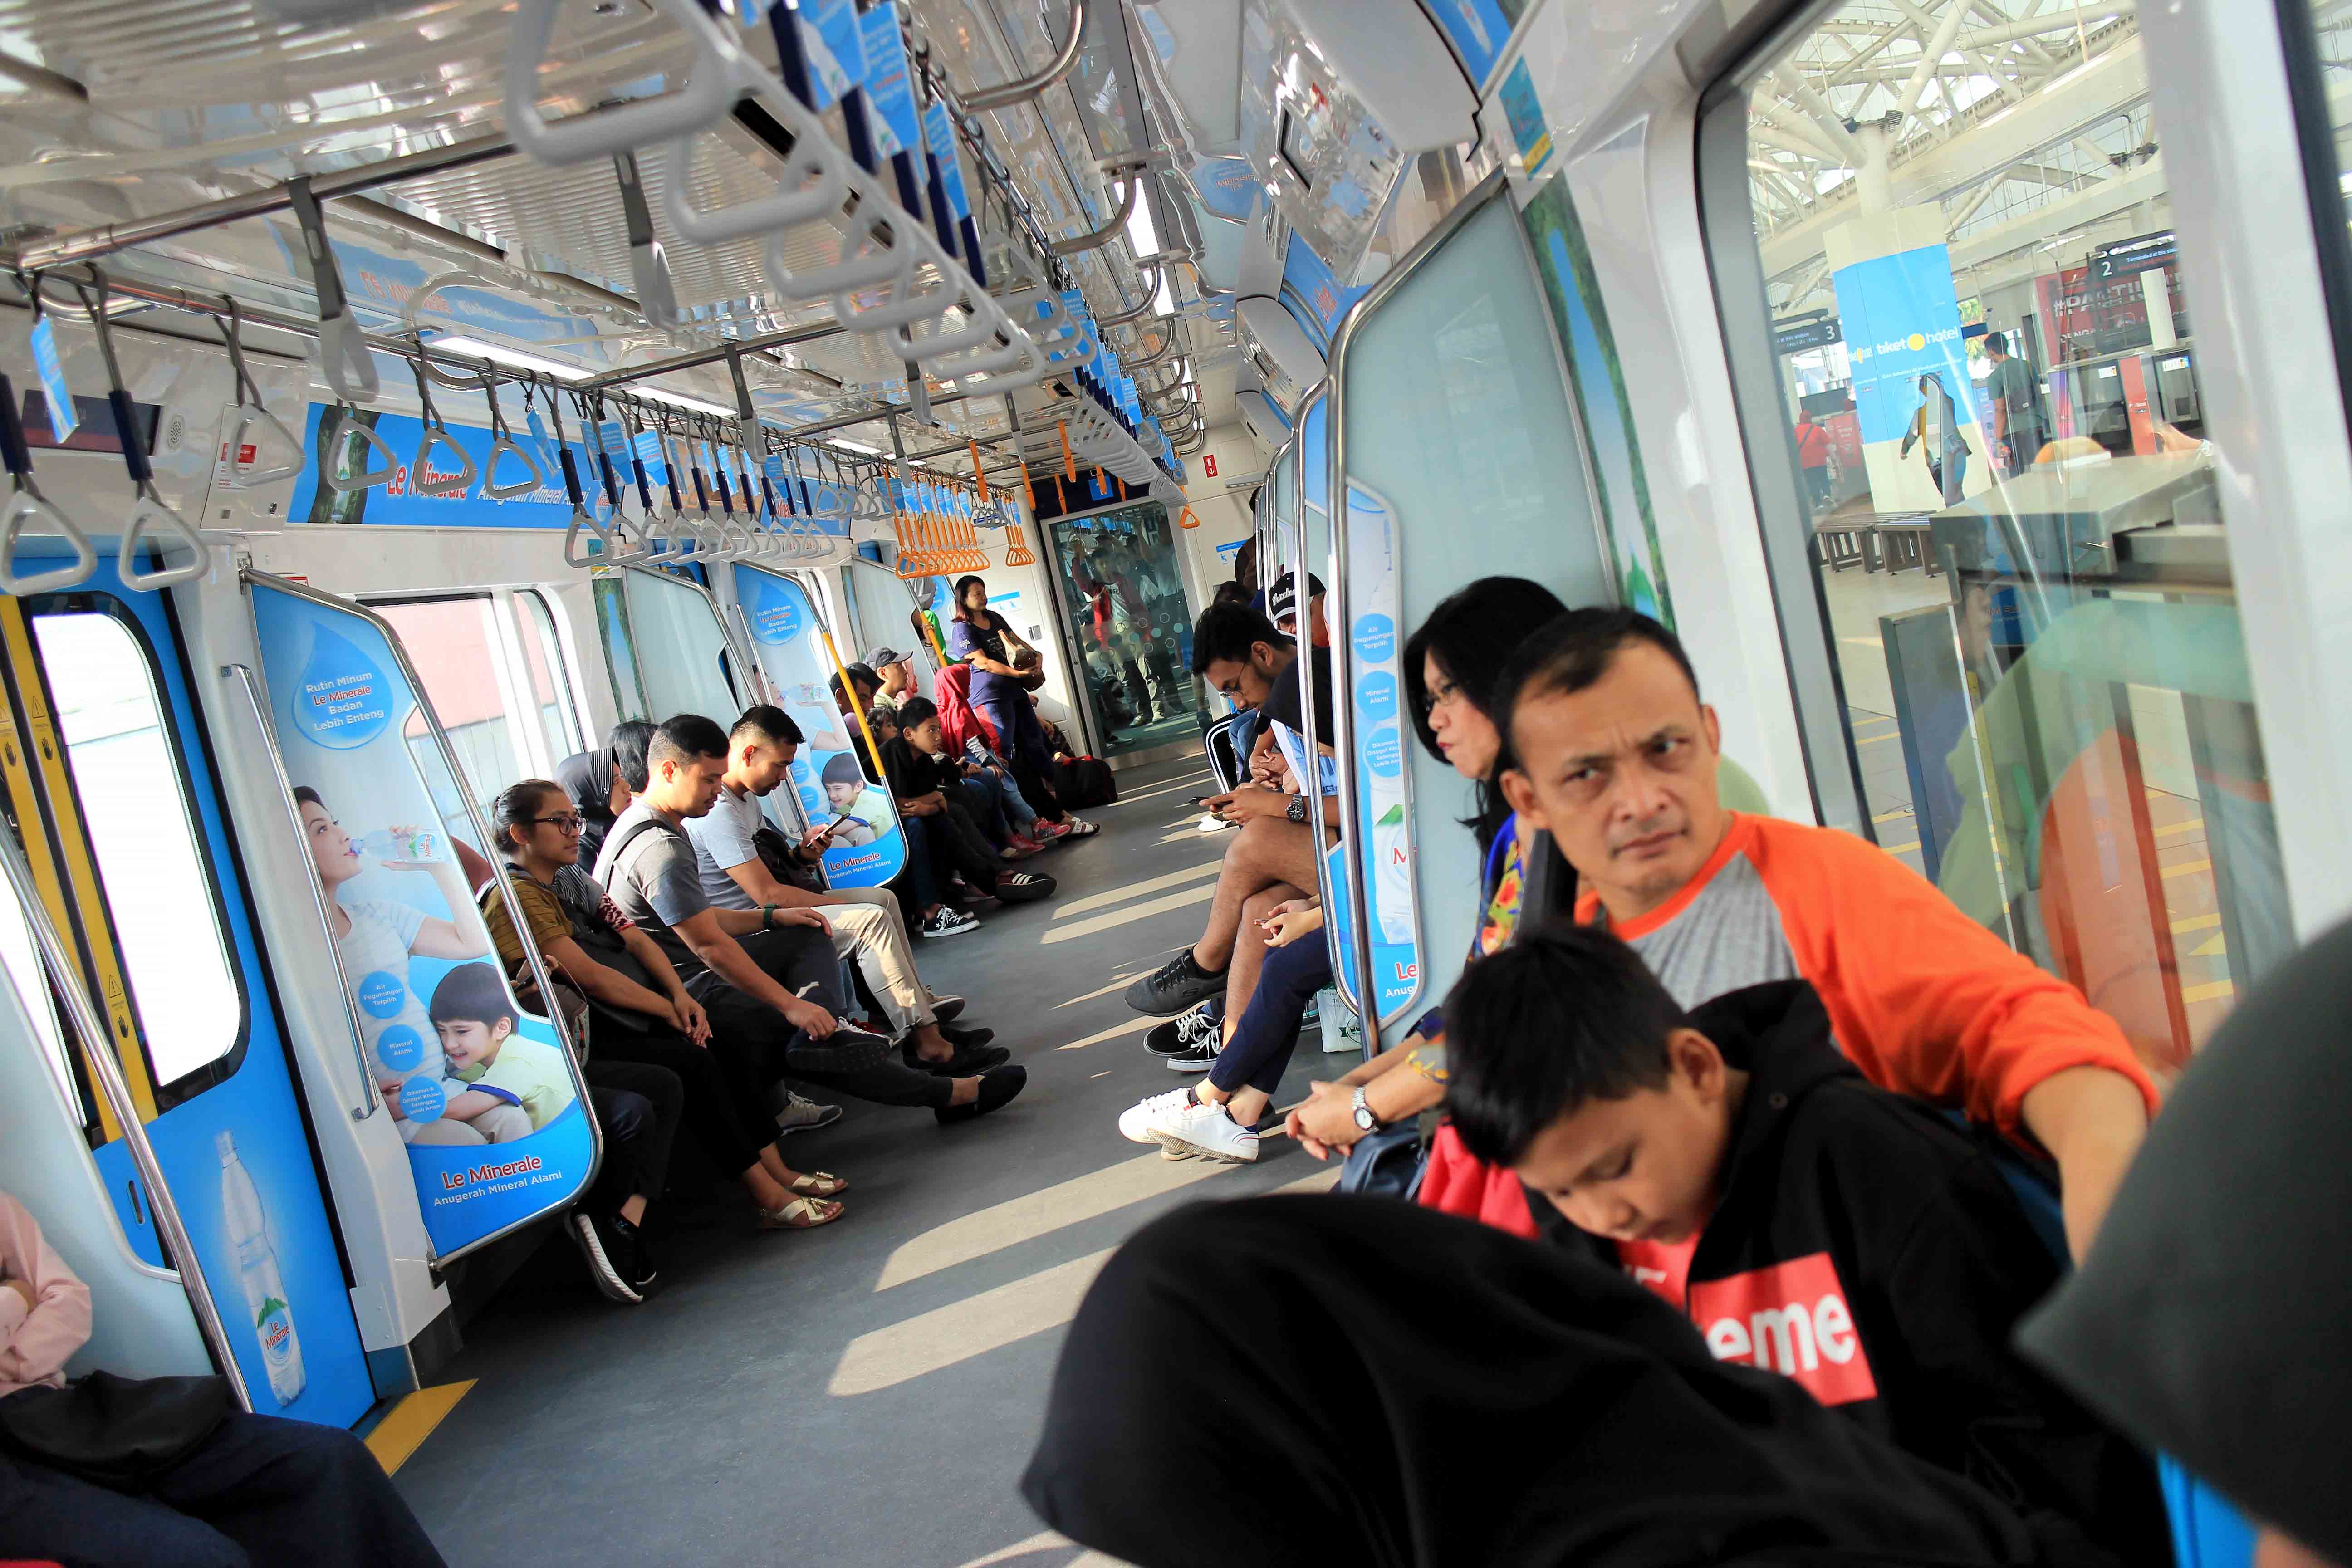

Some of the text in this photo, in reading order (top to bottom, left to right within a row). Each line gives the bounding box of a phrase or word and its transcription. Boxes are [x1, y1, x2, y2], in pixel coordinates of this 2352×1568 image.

[2102, 261, 2112, 276] 2
[1825, 325, 1835, 340] 3
[1925, 326, 1960, 344] hotel
[387, 466, 407, 495] Le
[529, 484, 562, 505] Mineral
[305, 672, 373, 693] Rutin Minum
[313, 686, 371, 706] Le Minerale
[328, 701, 363, 715] Badan
[314, 709, 385, 732] Lebih Enteng
[829, 852, 881, 871] Le Minerale
[828, 870, 853, 879] nugerah
[853, 864, 873, 873] Mineral
[1396, 963, 1417, 980] Le
[363, 988, 403, 1000] Pegunungan
[389, 1039, 413, 1049] Mineral
[442, 1156, 541, 1189] Le Minerale
[434, 1170, 563, 1207] Anugerah Mineral Alami
[270, 1322, 279, 1333] Le
[265, 1324, 289, 1350] Minerale
